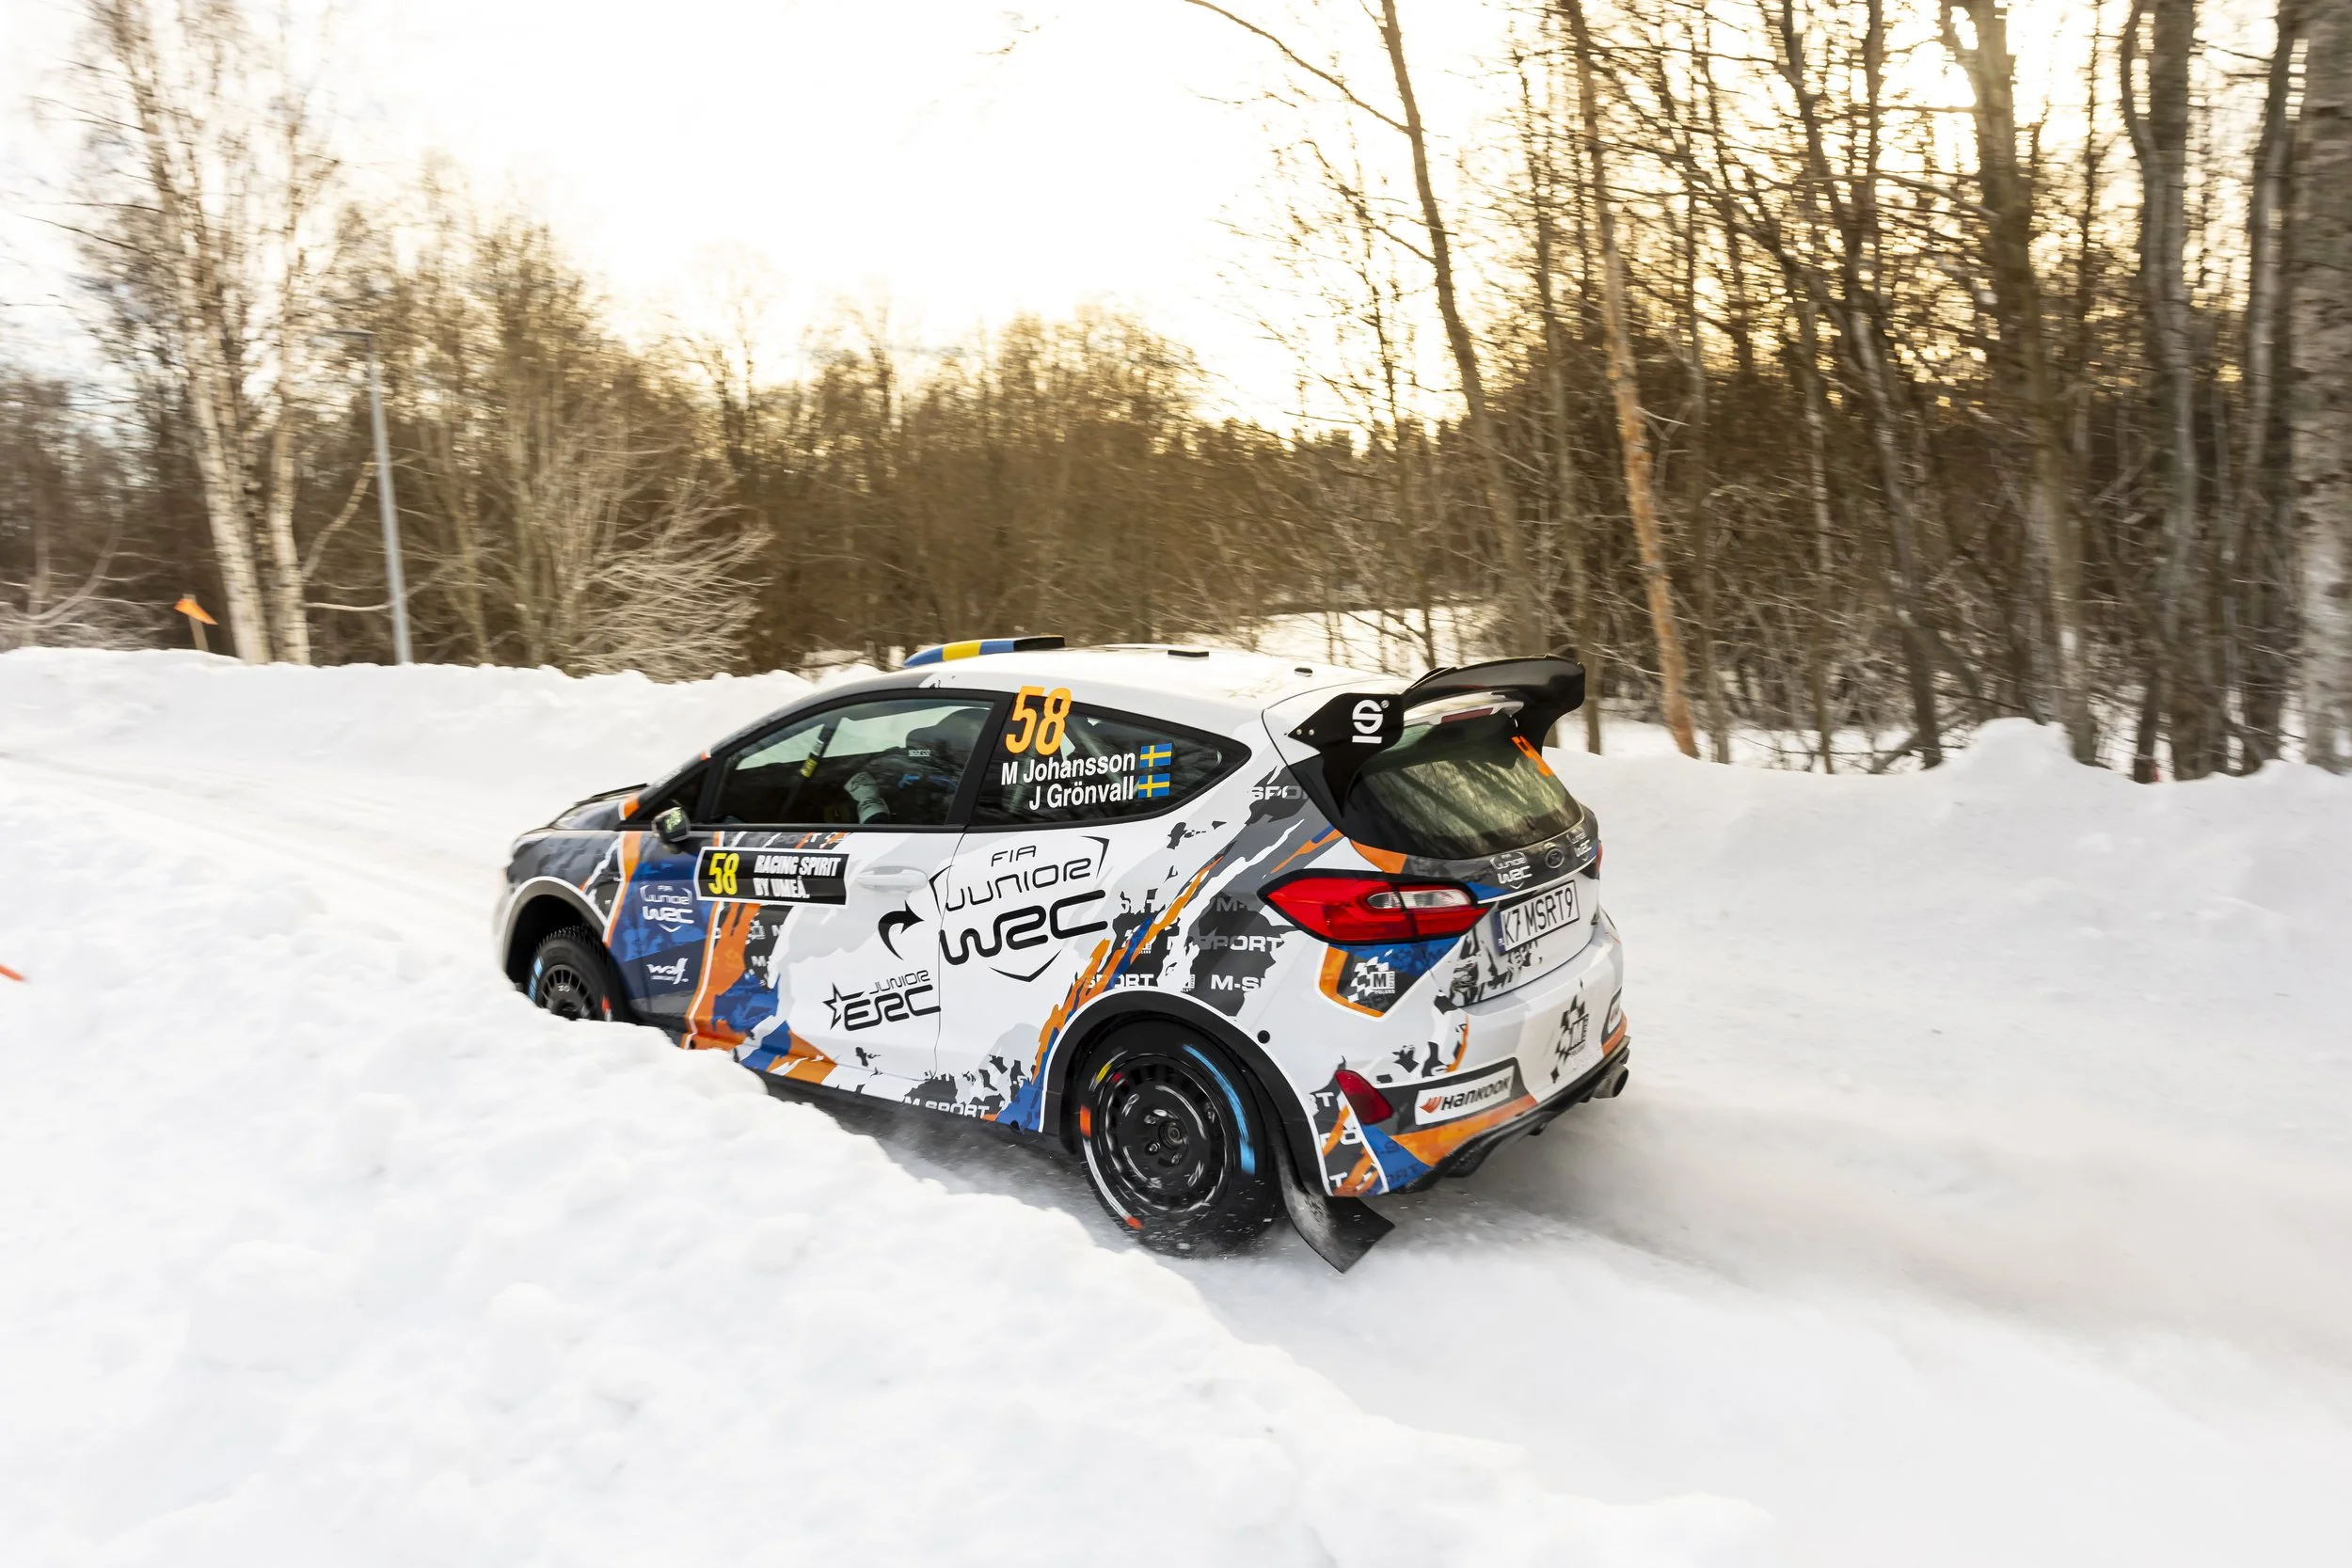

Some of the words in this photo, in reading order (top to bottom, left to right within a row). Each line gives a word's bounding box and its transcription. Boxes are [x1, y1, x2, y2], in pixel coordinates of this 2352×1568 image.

[1005, 686, 1072, 755] 58
[1001, 761, 1018, 785] M
[1023, 752, 1136, 784] Johansson
[1029, 786, 1041, 811] J
[1047, 776, 1135, 809] Grönvall
[754, 854, 799, 875] RACING
[799, 856, 842, 877] SPIRIT
[991, 845, 1037, 867] FIA
[707, 852, 740, 895] 58
[753, 878, 771, 896] BY
[945, 857, 1091, 912] JUNIOR
[1497, 865, 1533, 884] WRC
[643, 906, 695, 924] WRC
[938, 889, 1109, 966] WRC
[1503, 907, 1521, 946] K7
[1524, 887, 1574, 937] MSRT9
[868, 970, 930, 995] JUNIOR
[844, 984, 942, 1031] ERC
